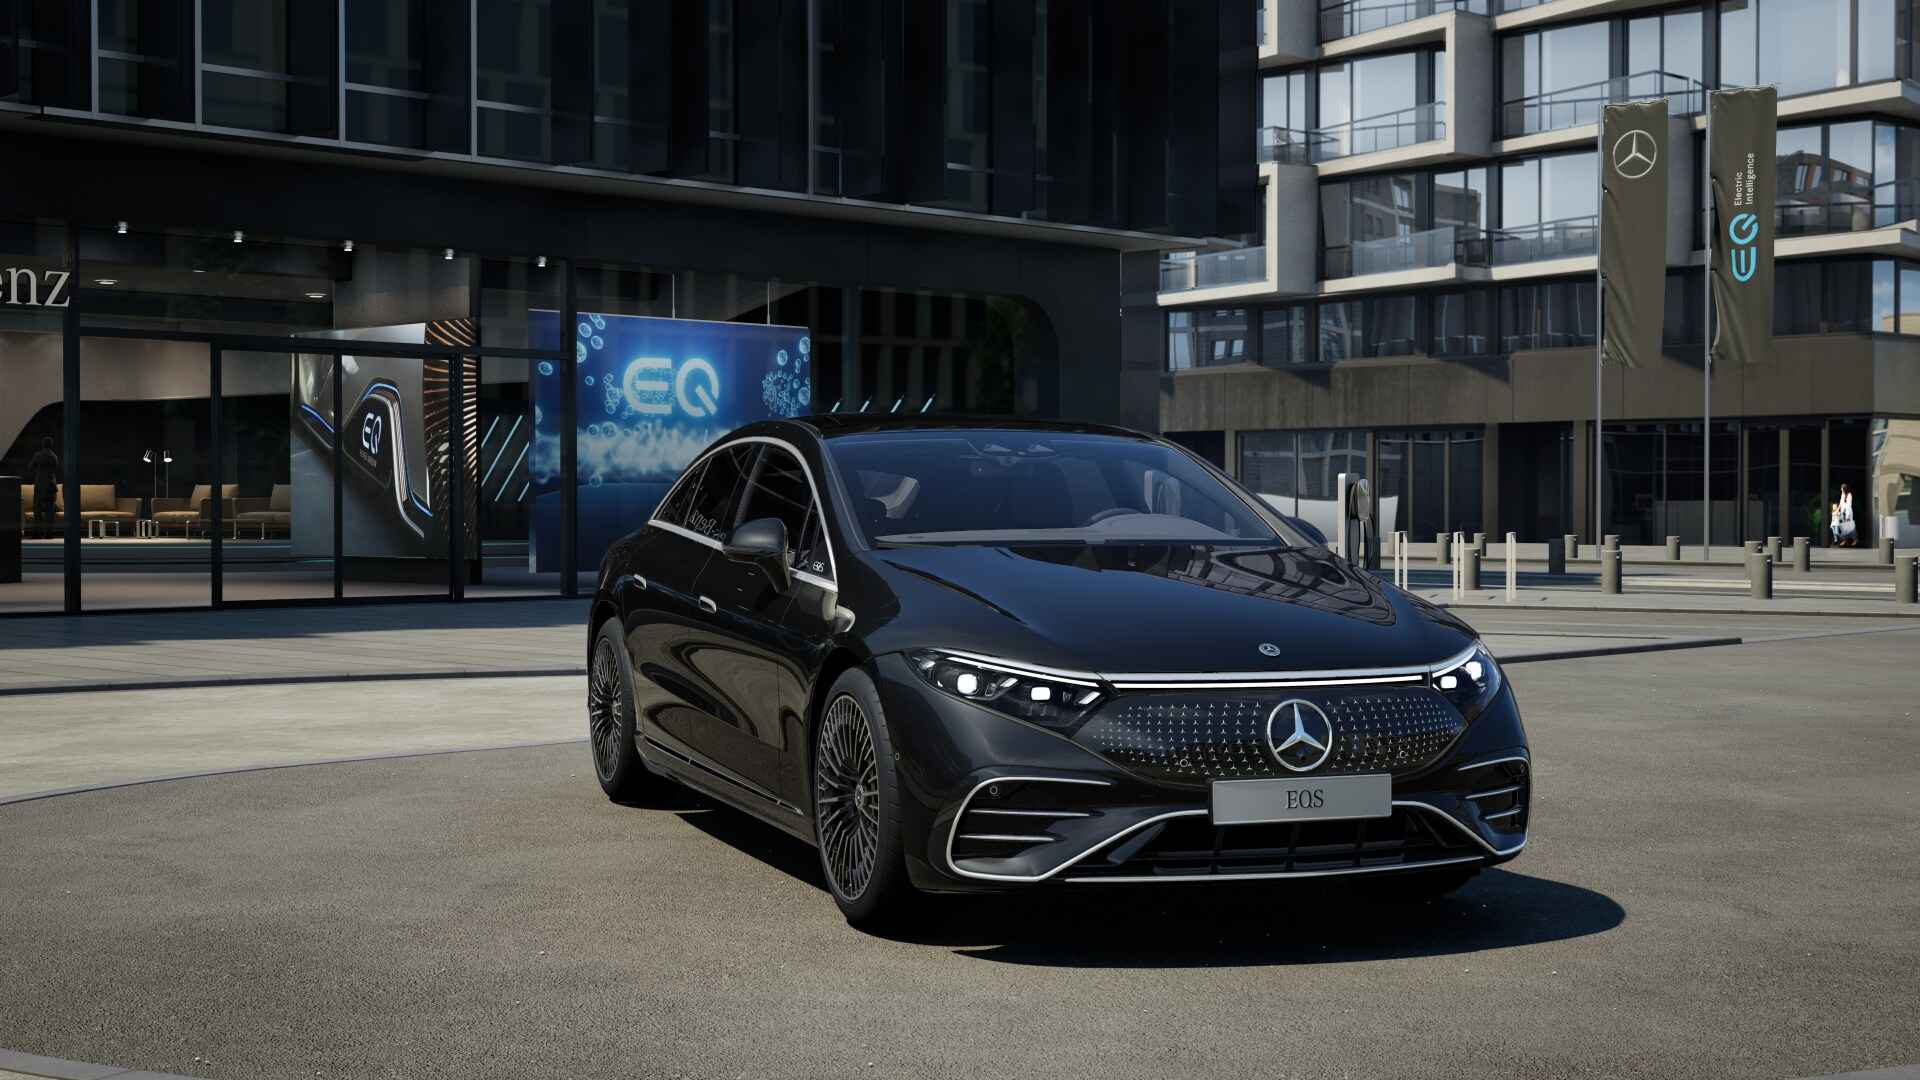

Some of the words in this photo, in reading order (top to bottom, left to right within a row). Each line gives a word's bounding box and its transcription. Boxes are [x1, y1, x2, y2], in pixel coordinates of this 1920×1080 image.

[1734, 171, 1743, 206] Electric
[1745, 152, 1756, 205] Intelligence
[1729, 212, 1759, 282] EQ
[0, 267, 71, 308] nz
[623, 357, 720, 417] EQ
[362, 412, 382, 454] EQ
[1286, 789, 1324, 809] EQS
